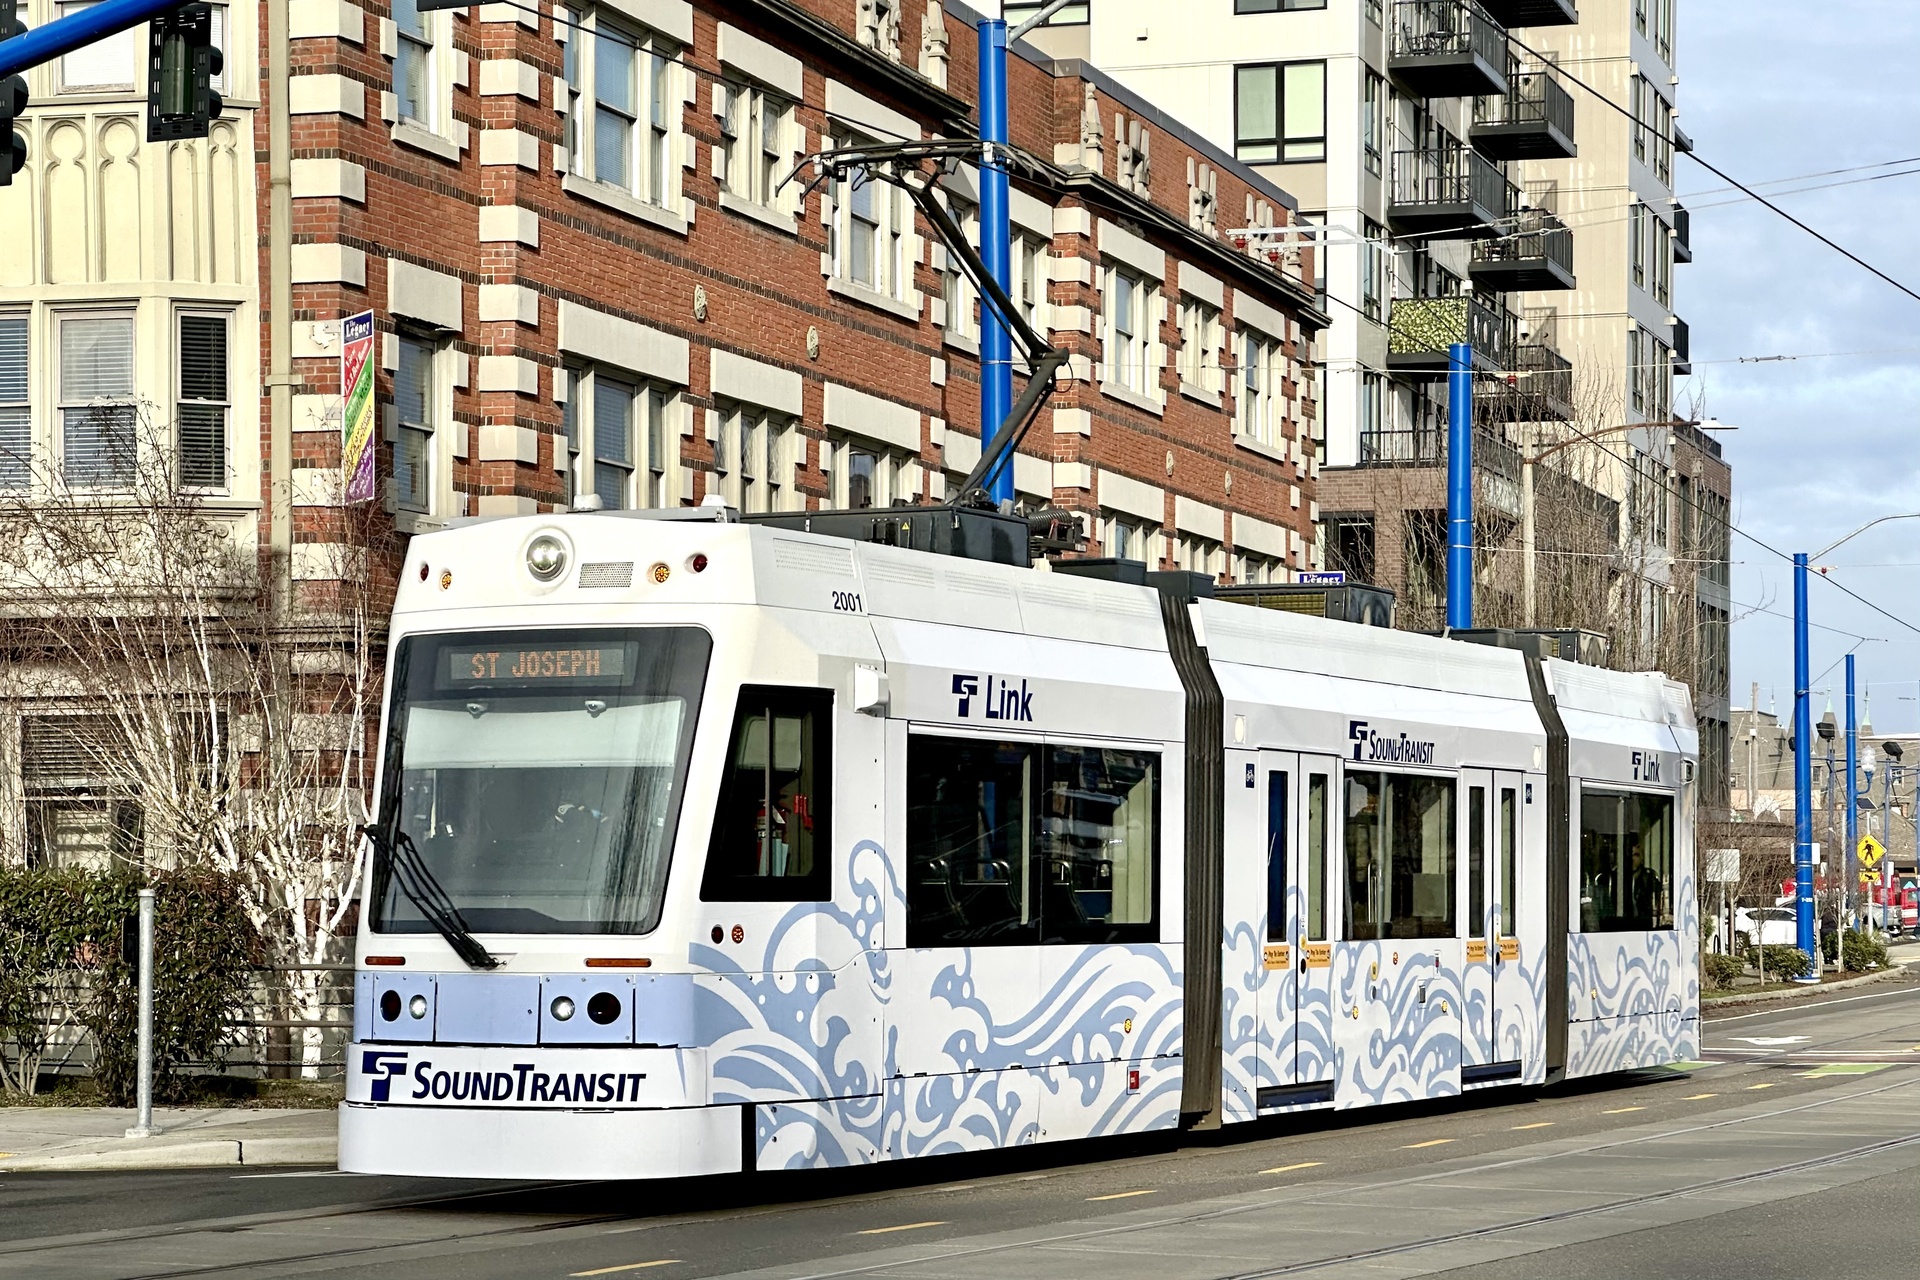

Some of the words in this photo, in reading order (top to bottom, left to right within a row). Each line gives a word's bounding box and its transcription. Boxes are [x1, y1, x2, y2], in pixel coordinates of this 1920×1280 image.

[346, 322, 370, 338] Legacy
[832, 591, 862, 612] 2001
[471, 652, 500, 678] ST
[511, 650, 600, 677] JOSEPH
[986, 674, 1033, 722] Link
[1644, 752, 1660, 782] Link
